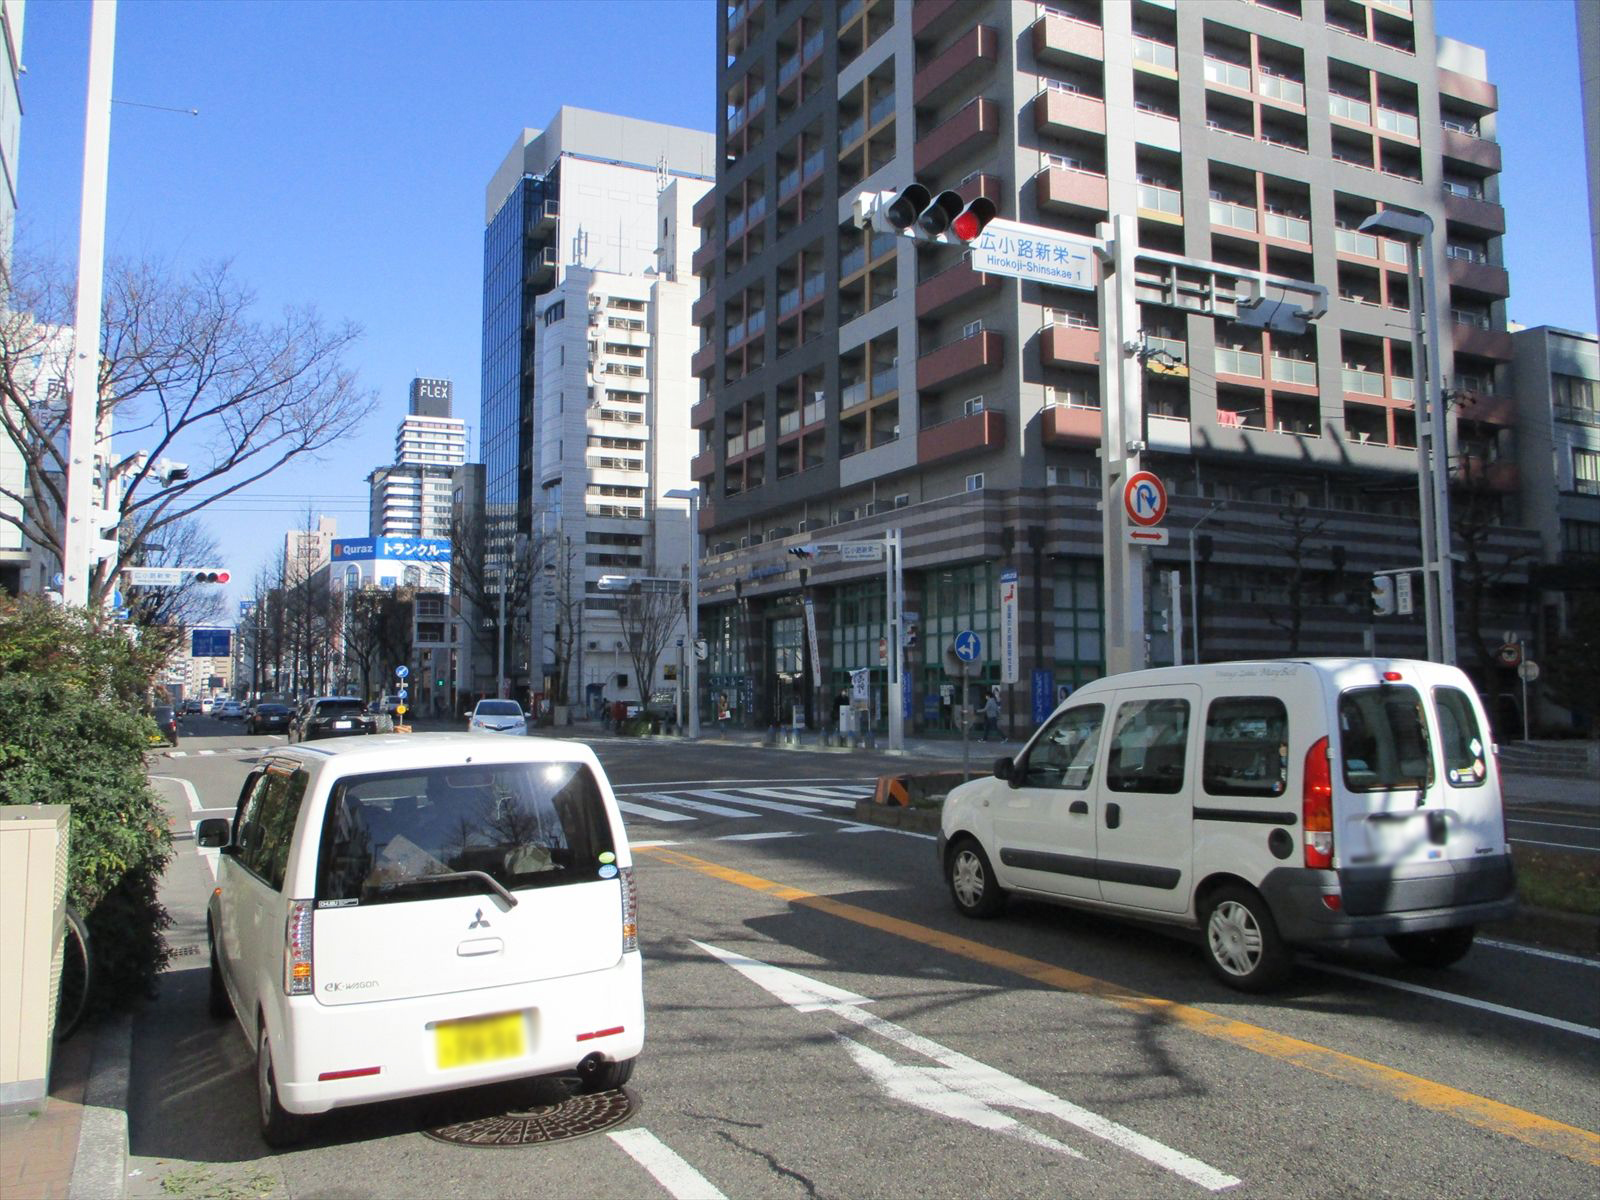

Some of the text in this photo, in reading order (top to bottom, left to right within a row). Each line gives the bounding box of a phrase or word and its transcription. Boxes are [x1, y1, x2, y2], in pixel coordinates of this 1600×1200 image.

[980, 232, 1086, 264] 広小路新栄一
[987, 254, 1081, 281] Hirokoji-Shinsakae 1
[420, 385, 448, 399] FLEX
[343, 544, 373, 555] Quraz
